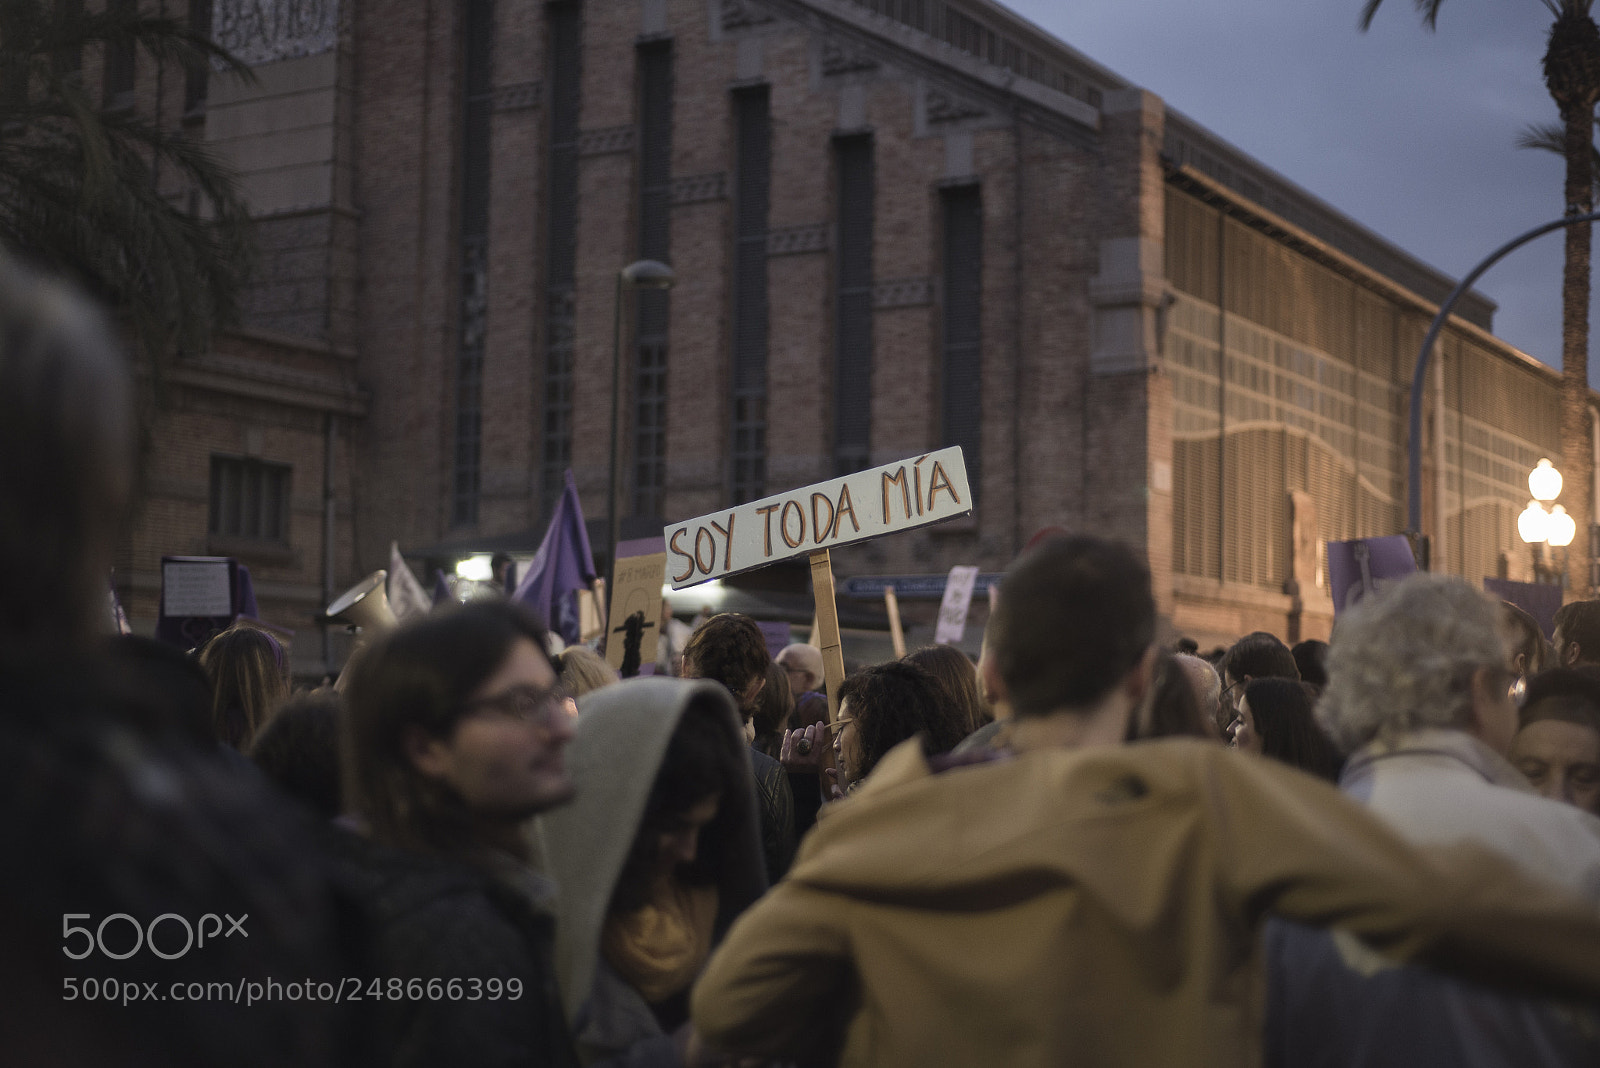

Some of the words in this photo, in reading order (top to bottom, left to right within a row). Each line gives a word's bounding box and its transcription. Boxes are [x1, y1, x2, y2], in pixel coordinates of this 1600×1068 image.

[670, 513, 736, 583] SOY
[756, 483, 860, 557] TODA
[882, 454, 961, 525] MÍA
